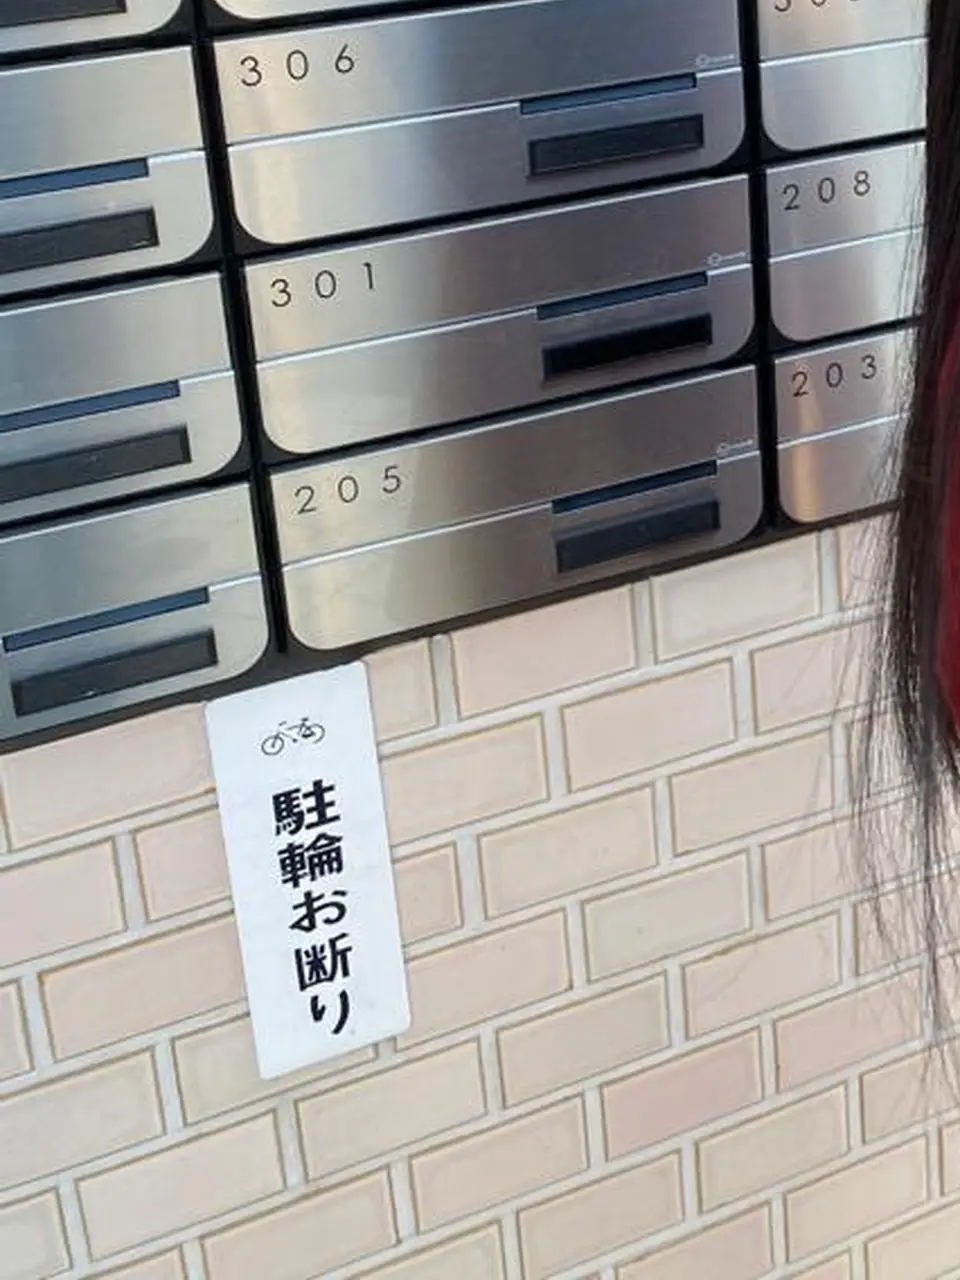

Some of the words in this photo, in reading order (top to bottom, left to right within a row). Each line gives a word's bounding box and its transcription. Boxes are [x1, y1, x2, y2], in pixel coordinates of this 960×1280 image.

[239, 43, 355, 88] 306
[782, 170, 873, 211] 208
[270, 261, 375, 308] 301
[791, 353, 878, 399] 203
[293, 464, 403, 516] 205
[272, 779, 353, 1035] 駐輪お断り
